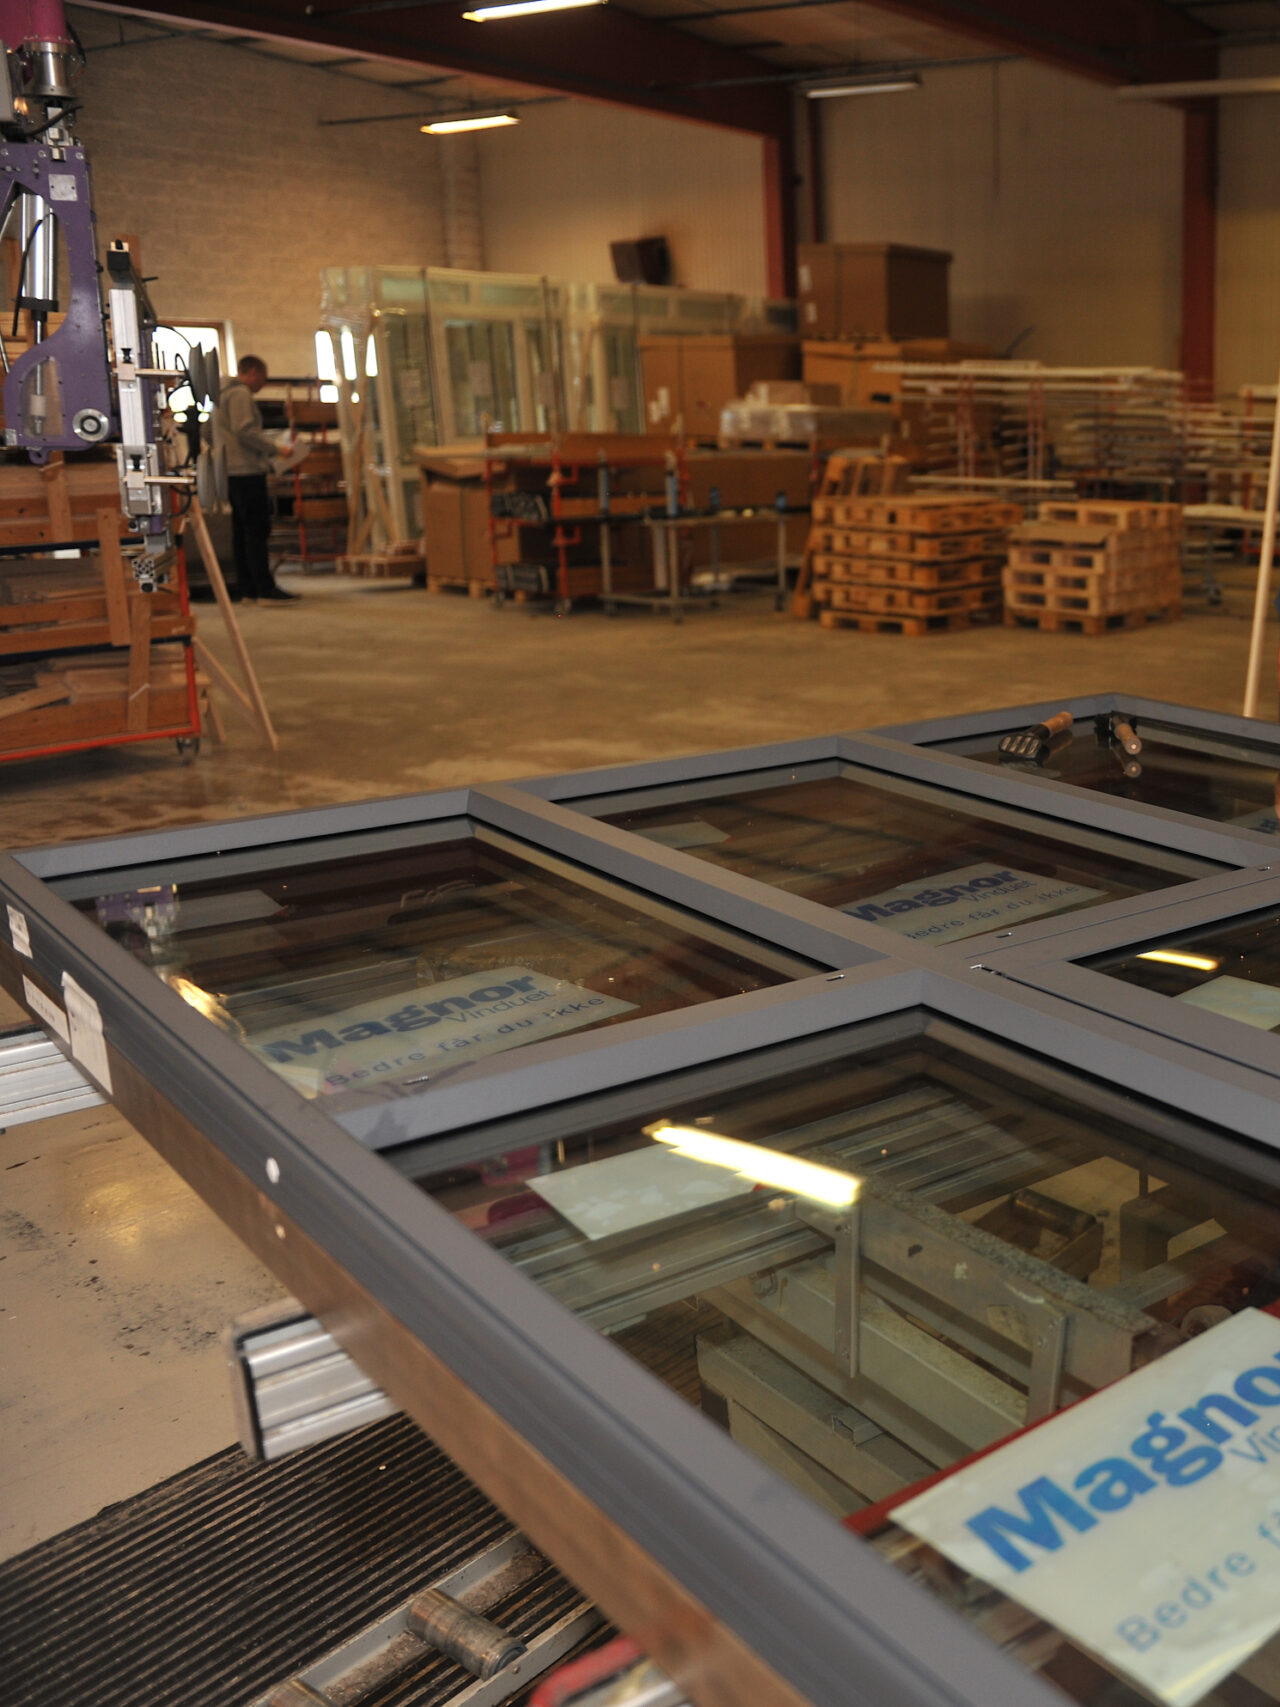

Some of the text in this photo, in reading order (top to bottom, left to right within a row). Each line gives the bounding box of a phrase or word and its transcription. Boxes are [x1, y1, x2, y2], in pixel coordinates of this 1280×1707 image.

[842, 871, 1018, 922] Magnor
[971, 880, 1037, 902] Vinduet
[1007, 898, 1033, 910] du
[262, 975, 537, 1064] Magnor
[445, 988, 557, 1024] Vinduet
[325, 997, 606, 1087] Bedre får du ikke
[1115, 1549, 1257, 1654] Bedre
